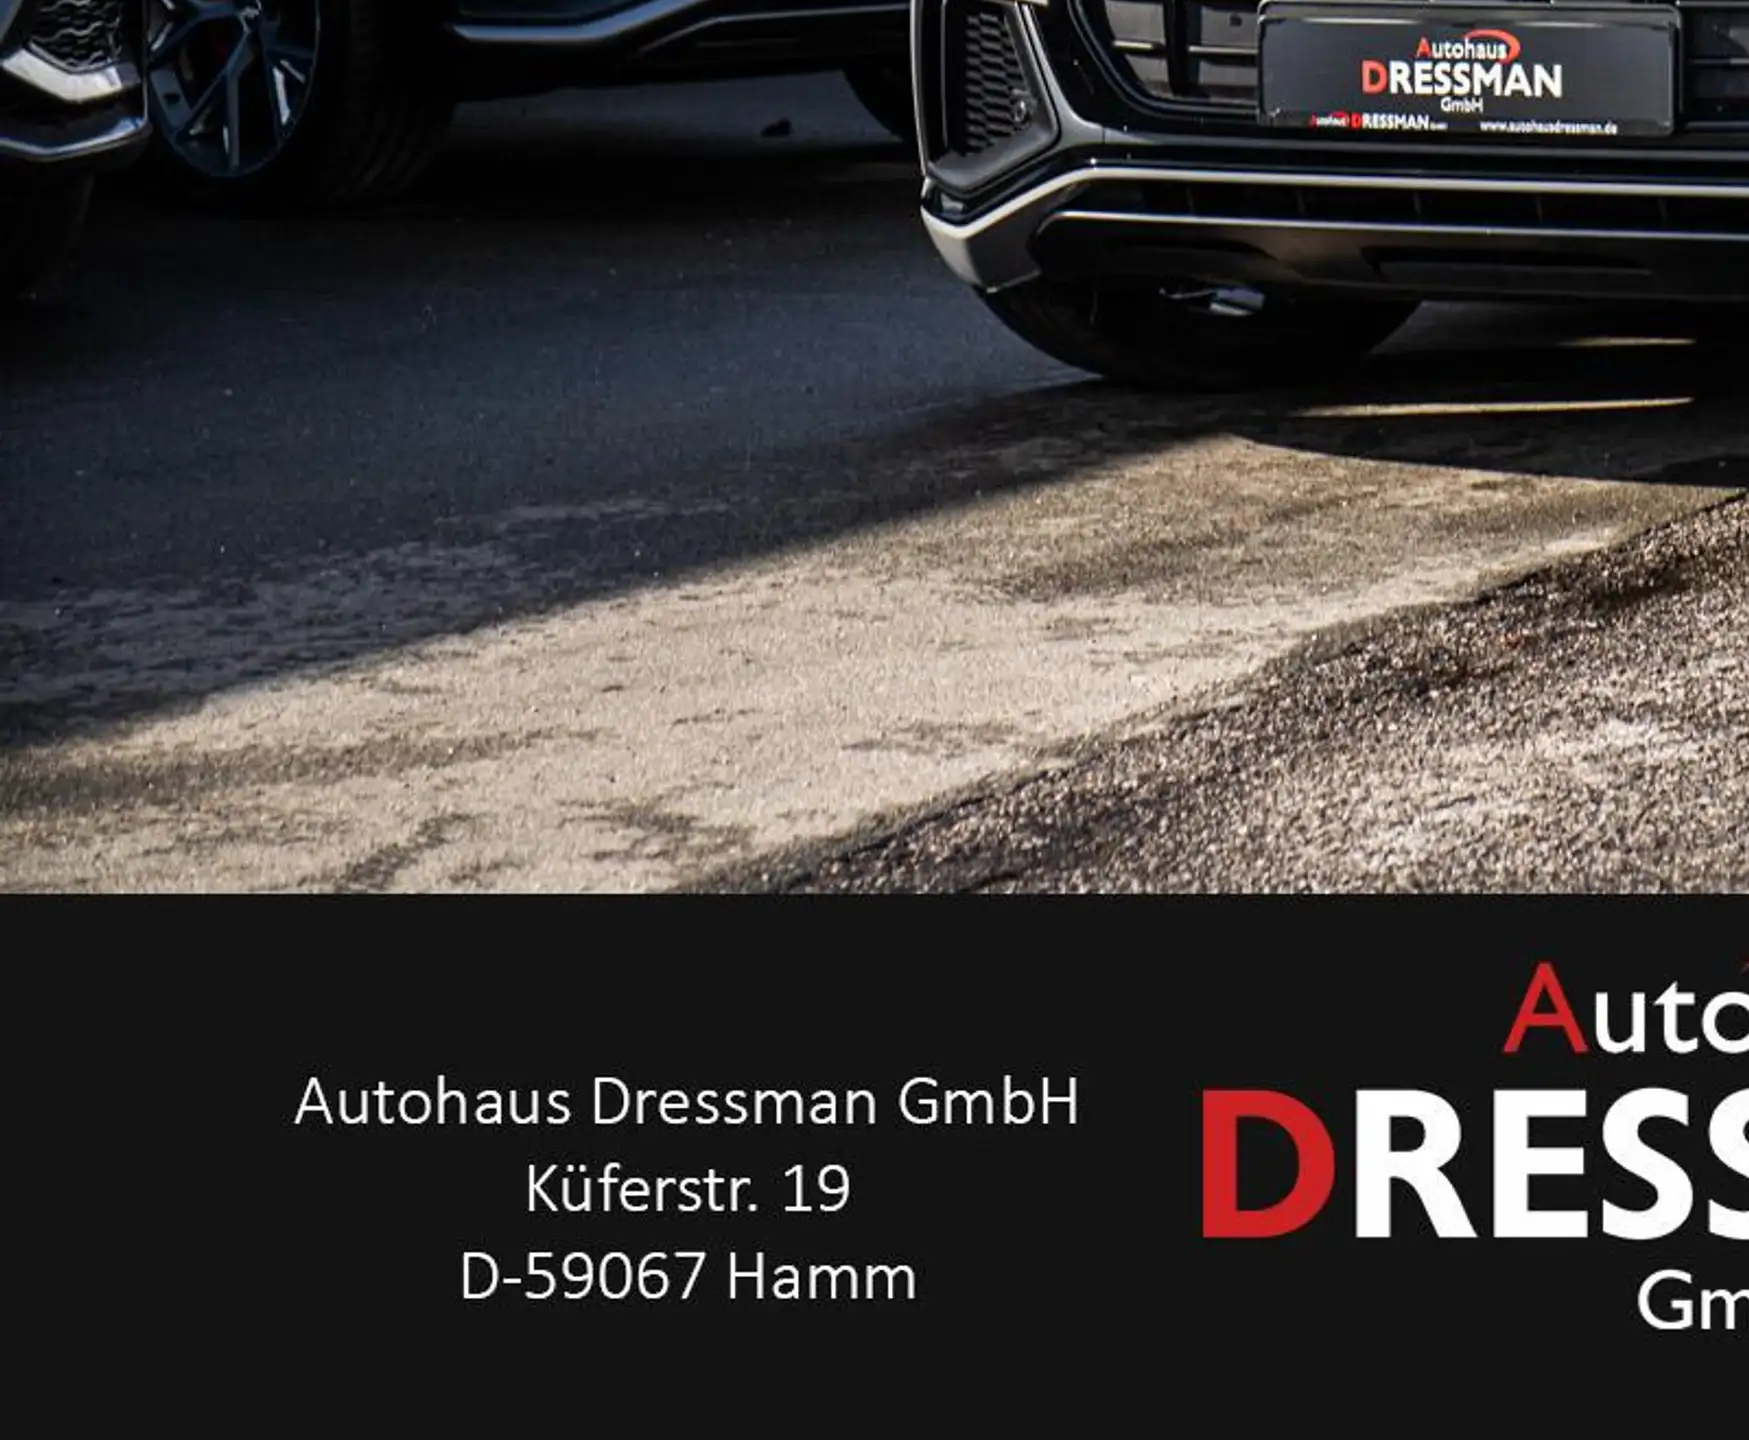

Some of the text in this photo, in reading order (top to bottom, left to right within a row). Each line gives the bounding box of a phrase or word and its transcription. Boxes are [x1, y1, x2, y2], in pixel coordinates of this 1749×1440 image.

[1416, 36, 1508, 60] Autohaus
[1362, 60, 1563, 98] DRESSMAN
[1440, 96, 1484, 113] GmbH
[1351, 112, 1430, 131] DRESSMAN
